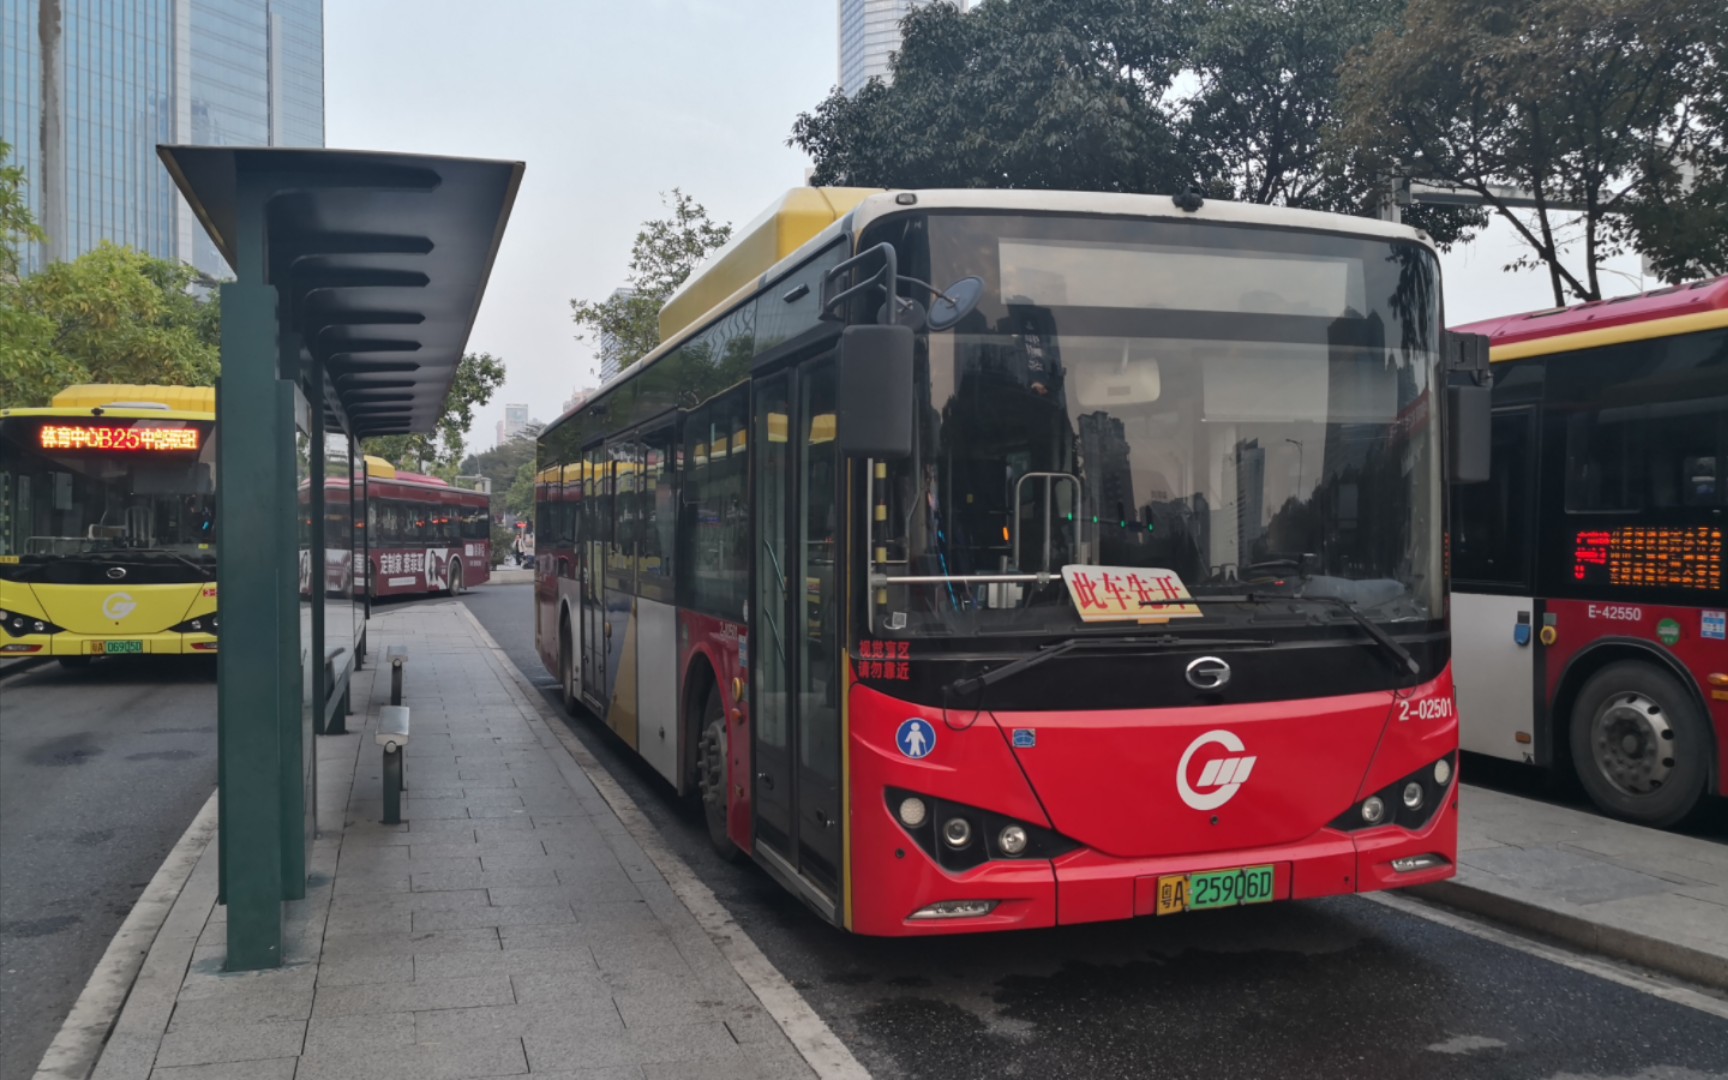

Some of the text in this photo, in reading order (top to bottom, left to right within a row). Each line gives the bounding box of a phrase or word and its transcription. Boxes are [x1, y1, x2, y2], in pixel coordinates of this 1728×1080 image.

[1072, 572, 1186, 611] 此车先开
[1588, 604, 1642, 621] E-42550
[859, 640, 911, 660] 视觉盲区
[859, 661, 911, 680] 请勿靠近
[1398, 697, 1453, 722] 2-02501
